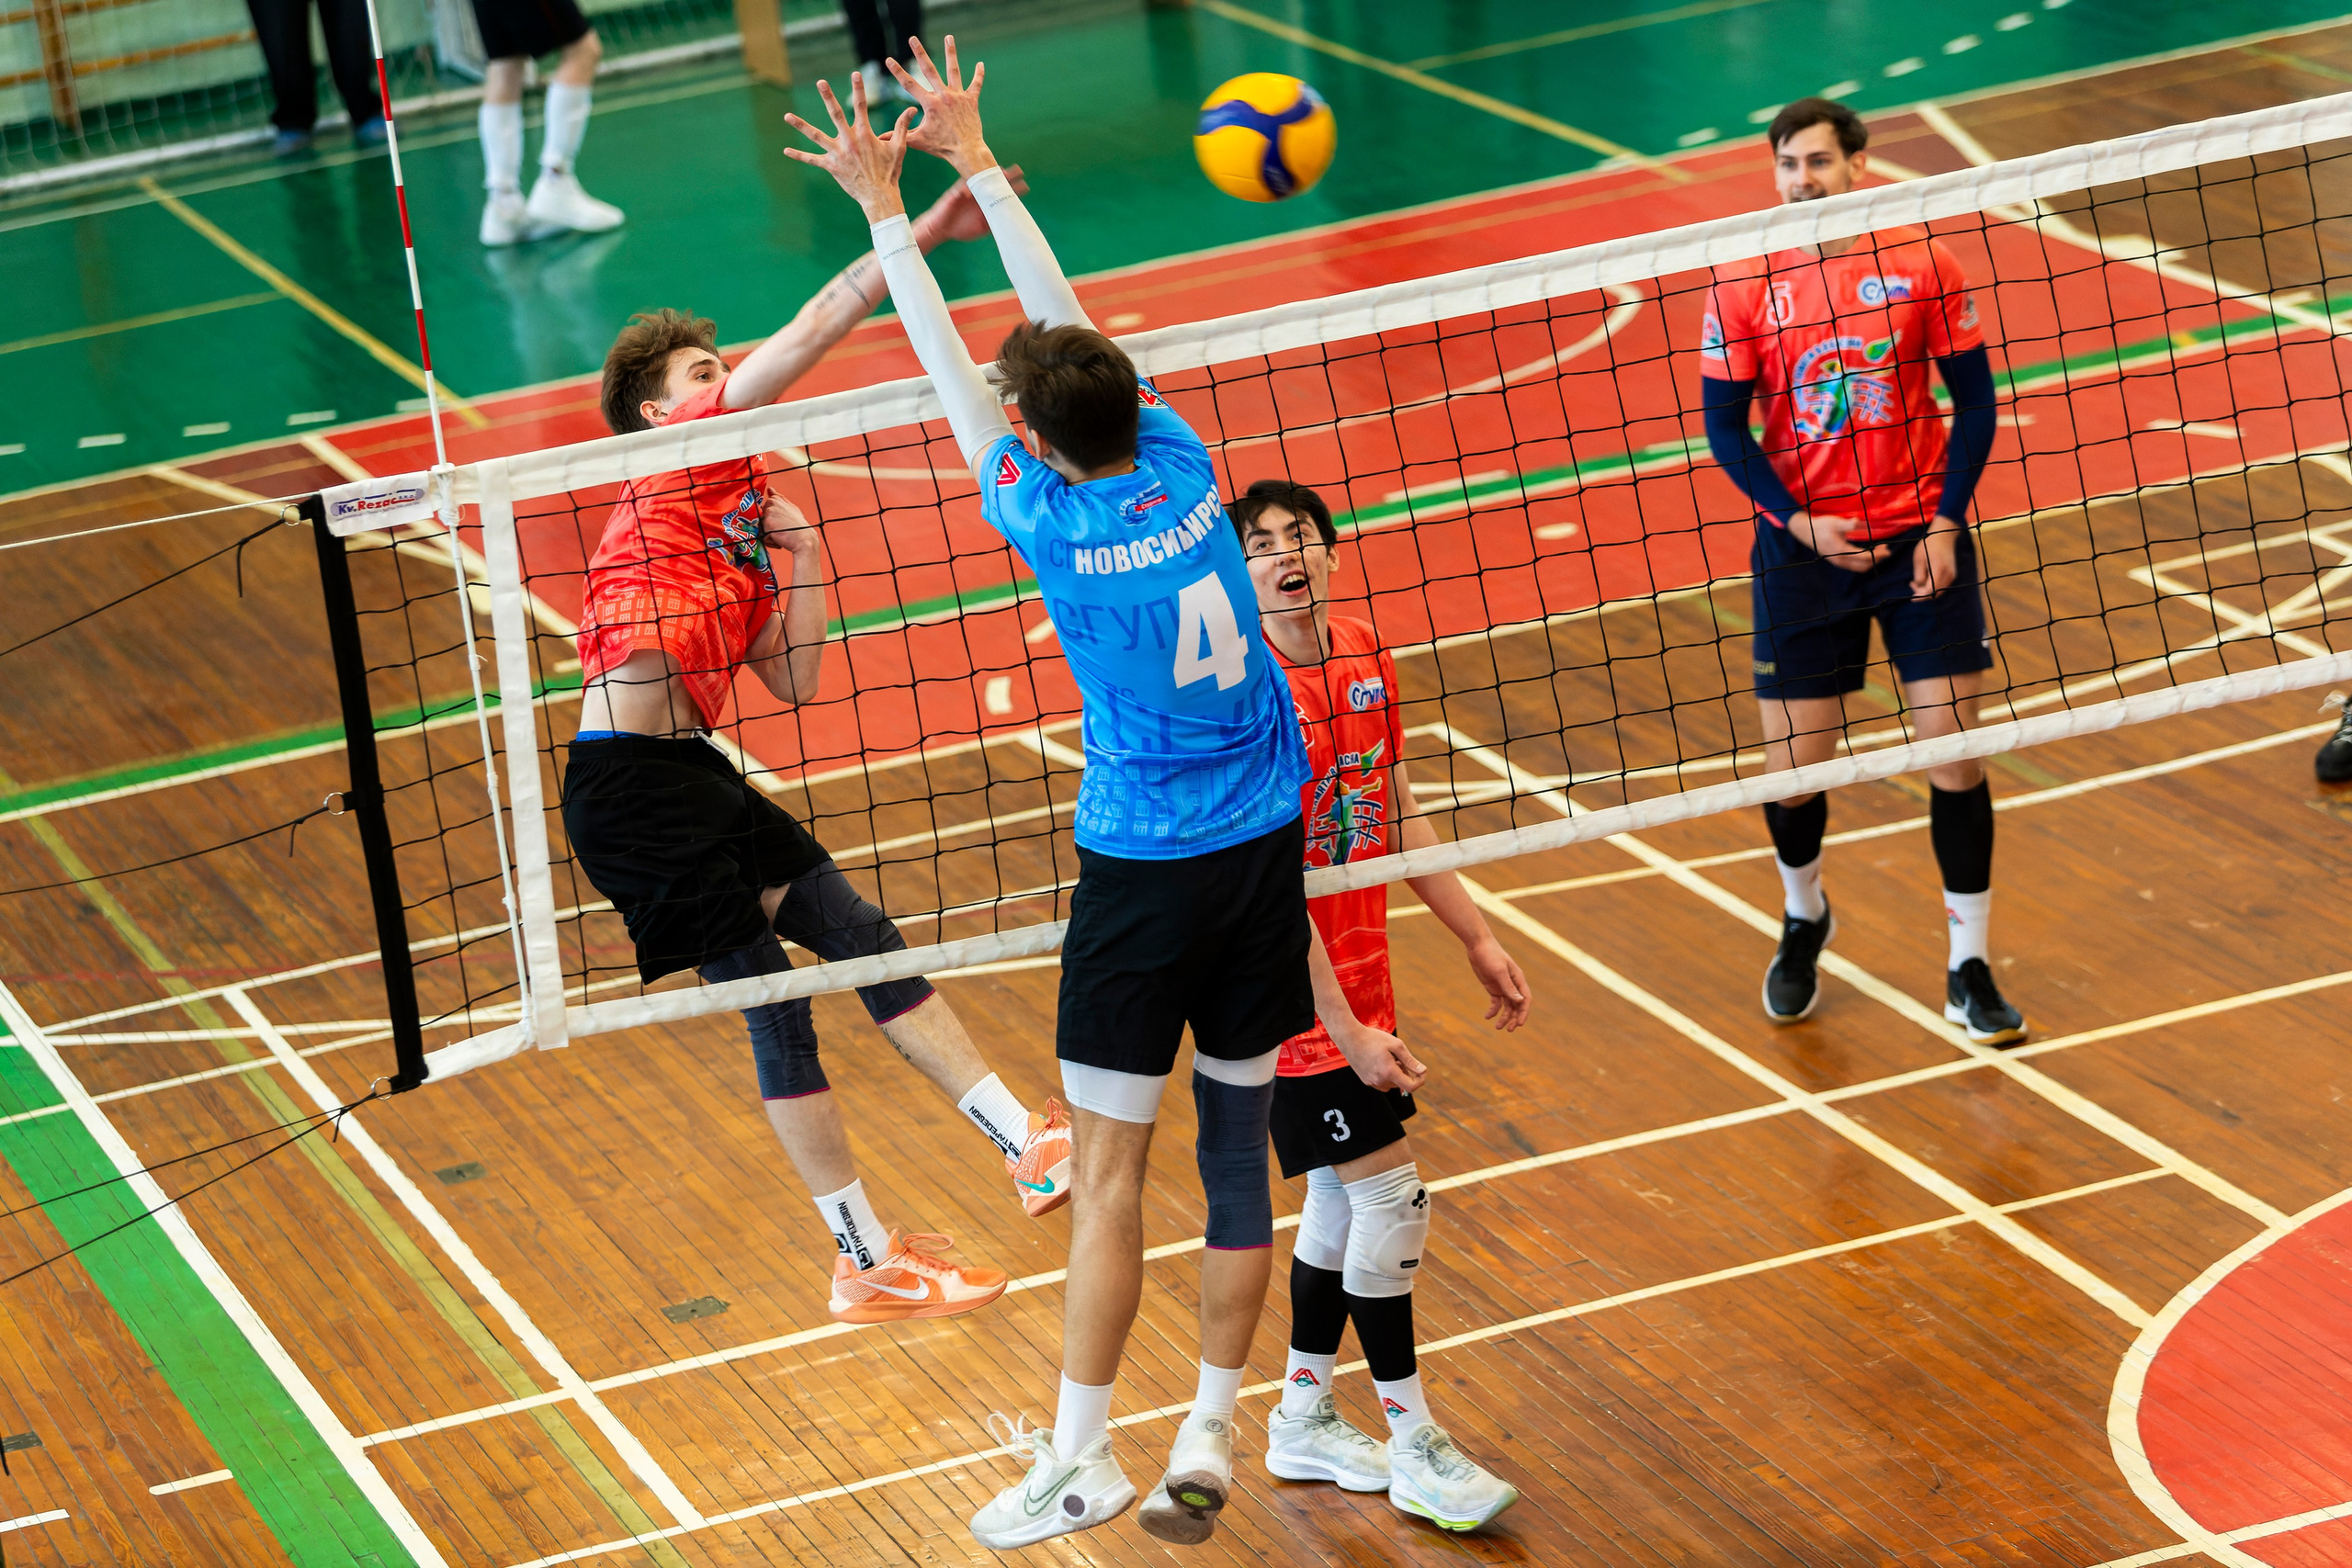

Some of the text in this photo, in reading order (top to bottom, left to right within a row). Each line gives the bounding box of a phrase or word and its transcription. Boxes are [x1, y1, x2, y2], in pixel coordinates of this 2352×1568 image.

[1172, 570, 1250, 692] 4
[968, 1105, 1010, 1146] TAPEDESIGN
[1323, 1108, 1351, 1142] 3
[837, 1201, 864, 1250] TAPEDESIGN
